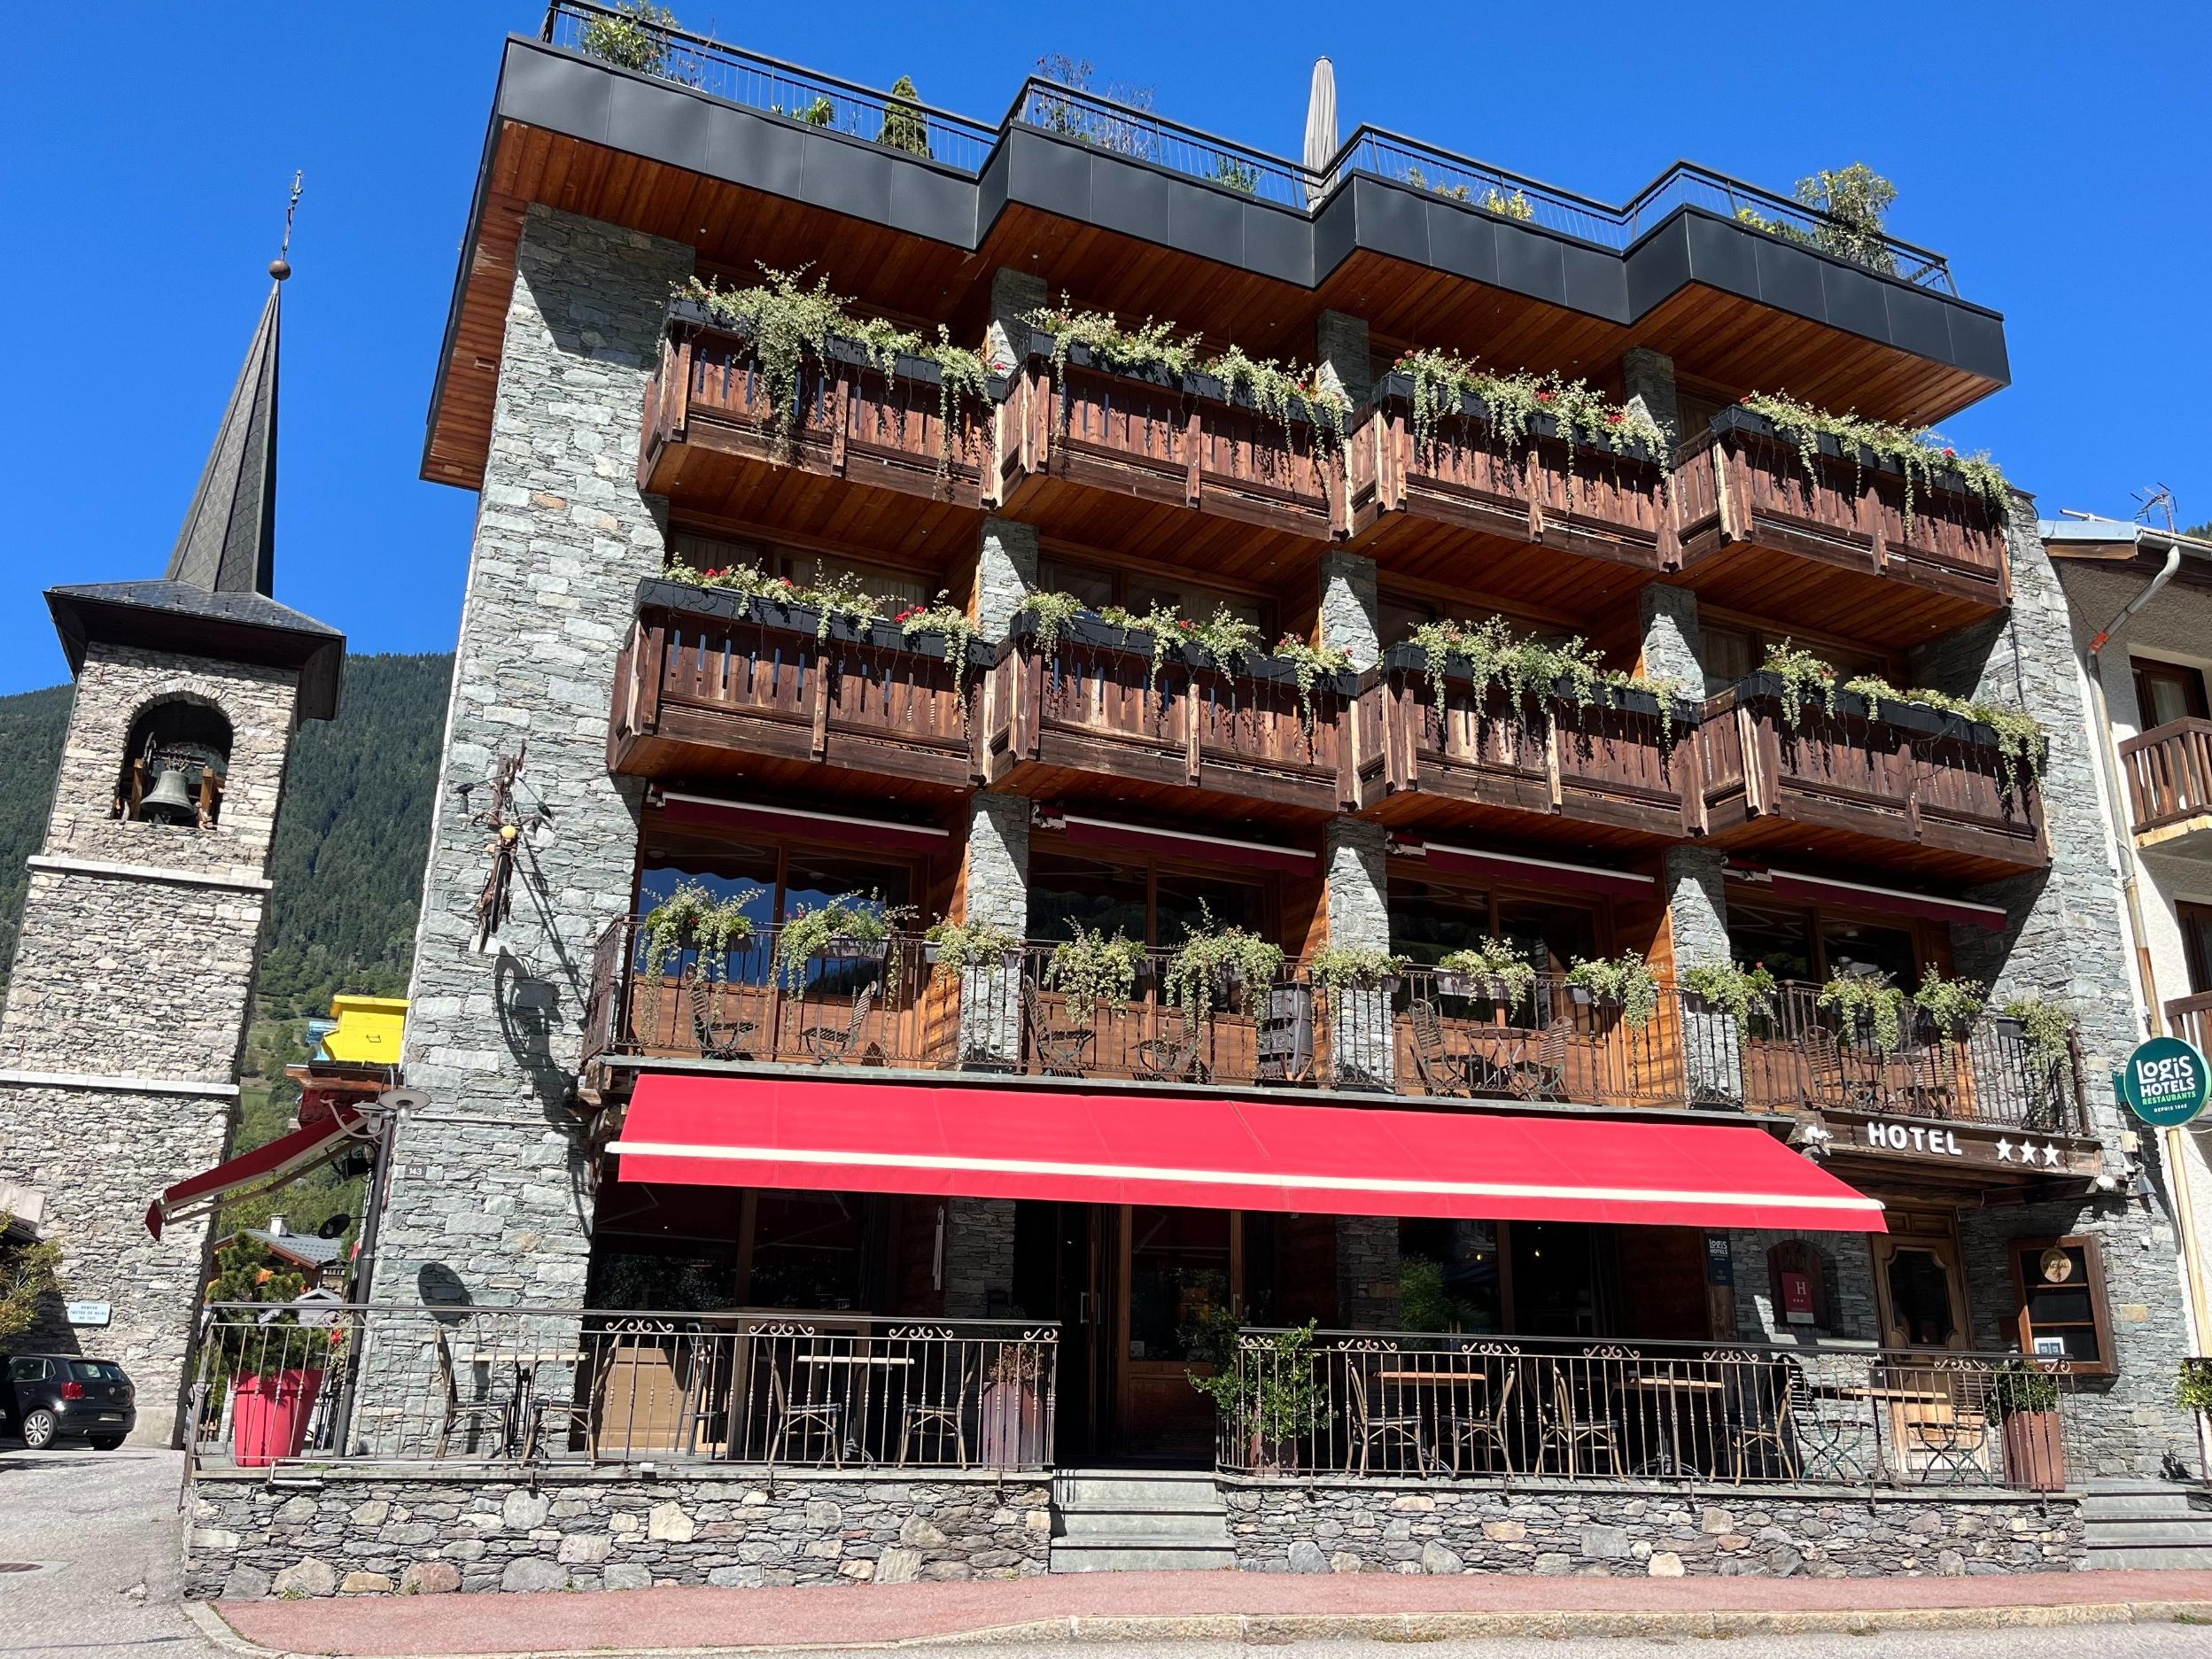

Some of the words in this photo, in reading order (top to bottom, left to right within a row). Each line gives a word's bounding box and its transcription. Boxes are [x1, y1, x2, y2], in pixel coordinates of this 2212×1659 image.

[2139, 1077, 2196, 1097] HOTELS
[2142, 1090, 2196, 1105] RESTAURANTS
[1867, 1121, 1963, 1156] HOTEL
[1796, 1281, 1806, 1295] H
